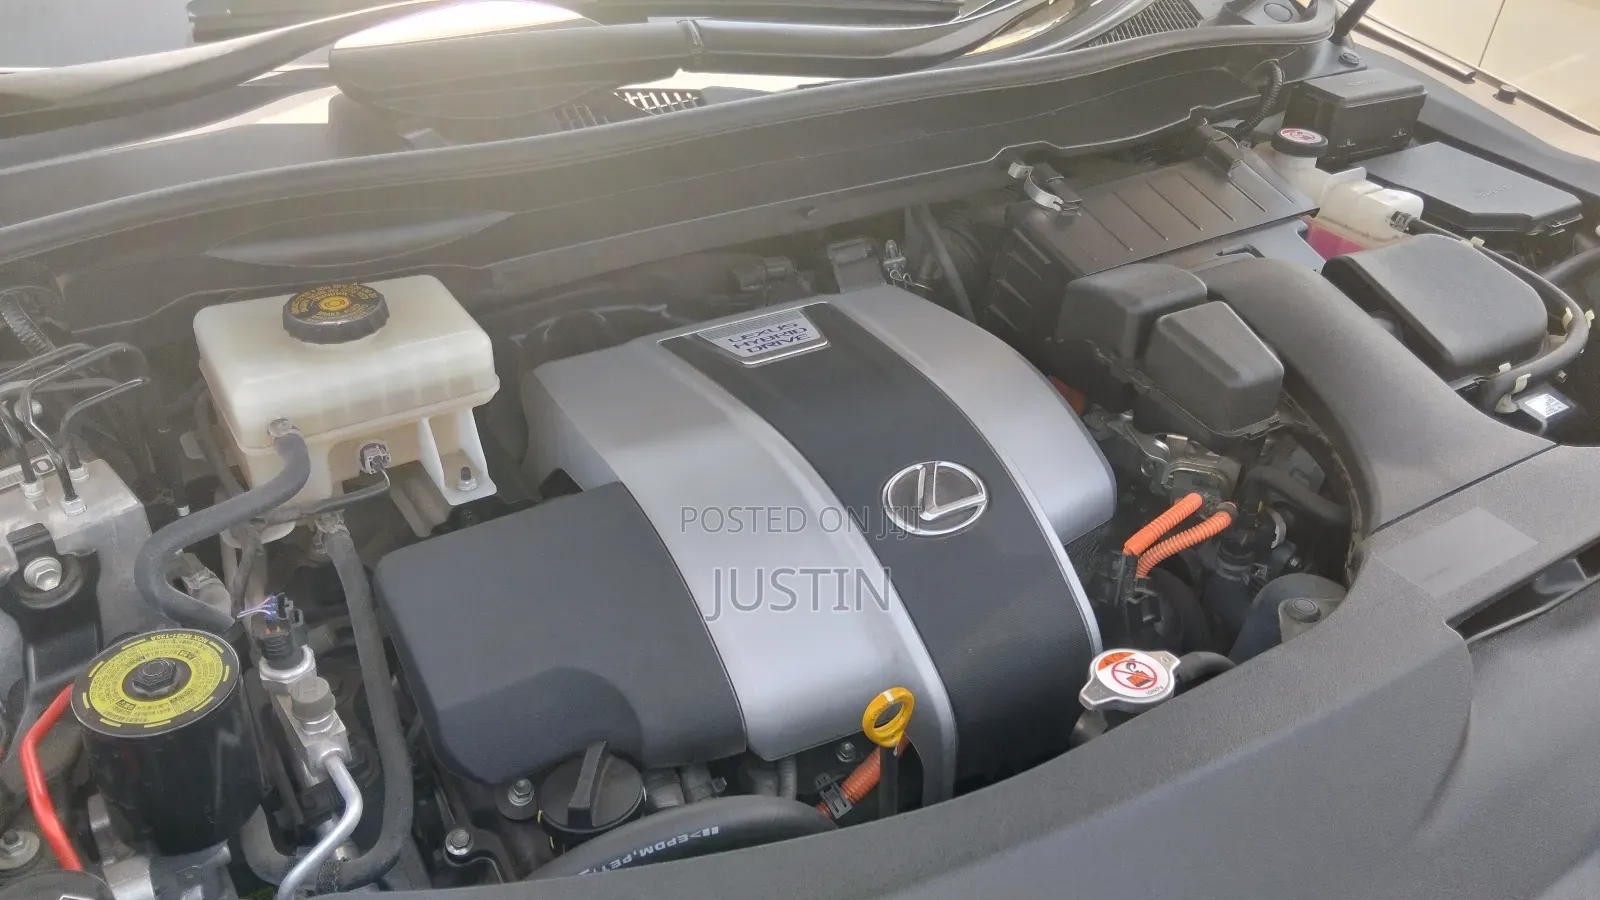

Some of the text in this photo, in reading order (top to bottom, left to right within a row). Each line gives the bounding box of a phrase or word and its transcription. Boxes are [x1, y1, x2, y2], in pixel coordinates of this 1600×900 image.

[728, 322, 798, 343] LEXUS
[732, 327, 808, 349] HYBRID
[746, 333, 811, 353] DRIVE
